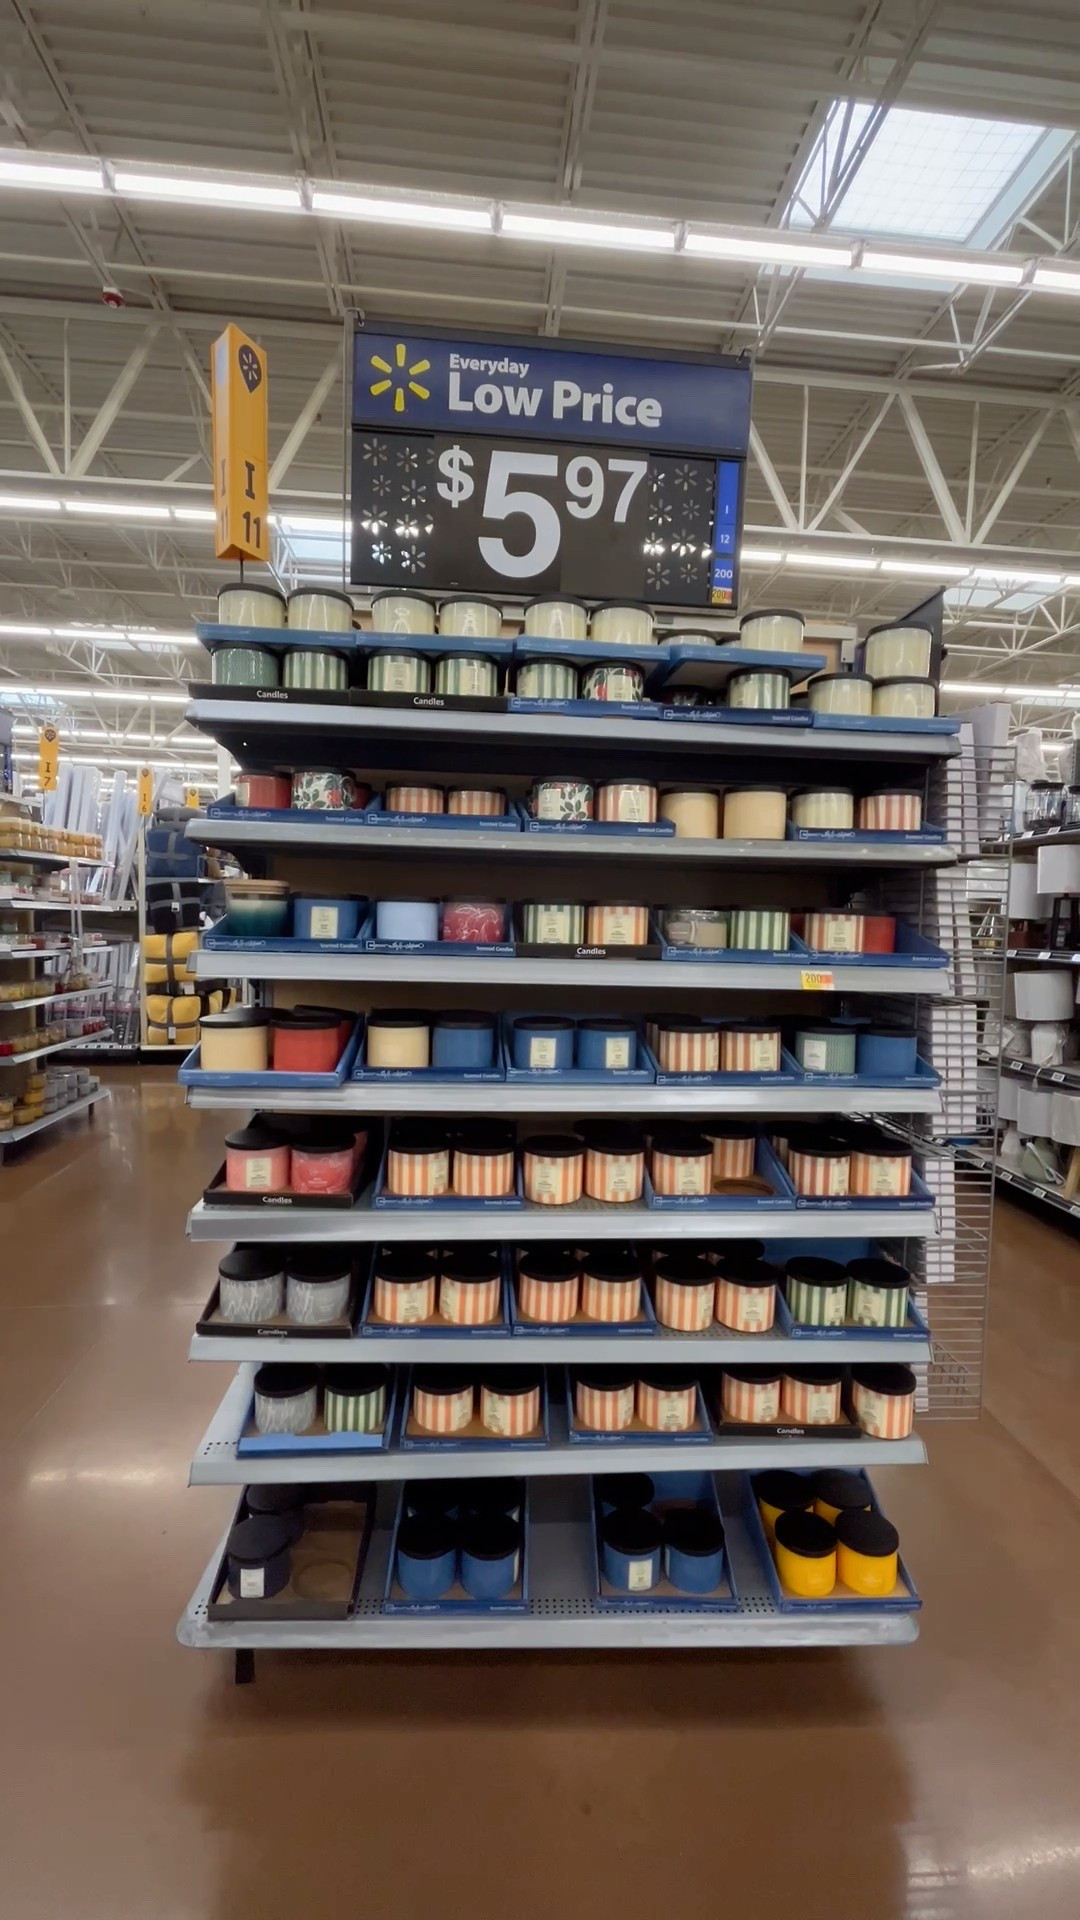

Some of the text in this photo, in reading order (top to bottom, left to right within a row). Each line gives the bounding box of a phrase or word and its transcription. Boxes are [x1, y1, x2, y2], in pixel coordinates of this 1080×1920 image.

[450, 353, 530, 378] Everyday
[448, 371, 663, 428] Low Price
[242, 511, 260, 549] 11
[720, 534, 730, 544] 12
[714, 568, 734, 580] 200
[256, 690, 289, 700] Candles
[413, 697, 445, 706] Candles
[44, 777, 50, 786] 7
[576, 947, 606, 955] Candles
[262, 1196, 293, 1204] Candles
[776, 1427, 805, 1435] Candles
